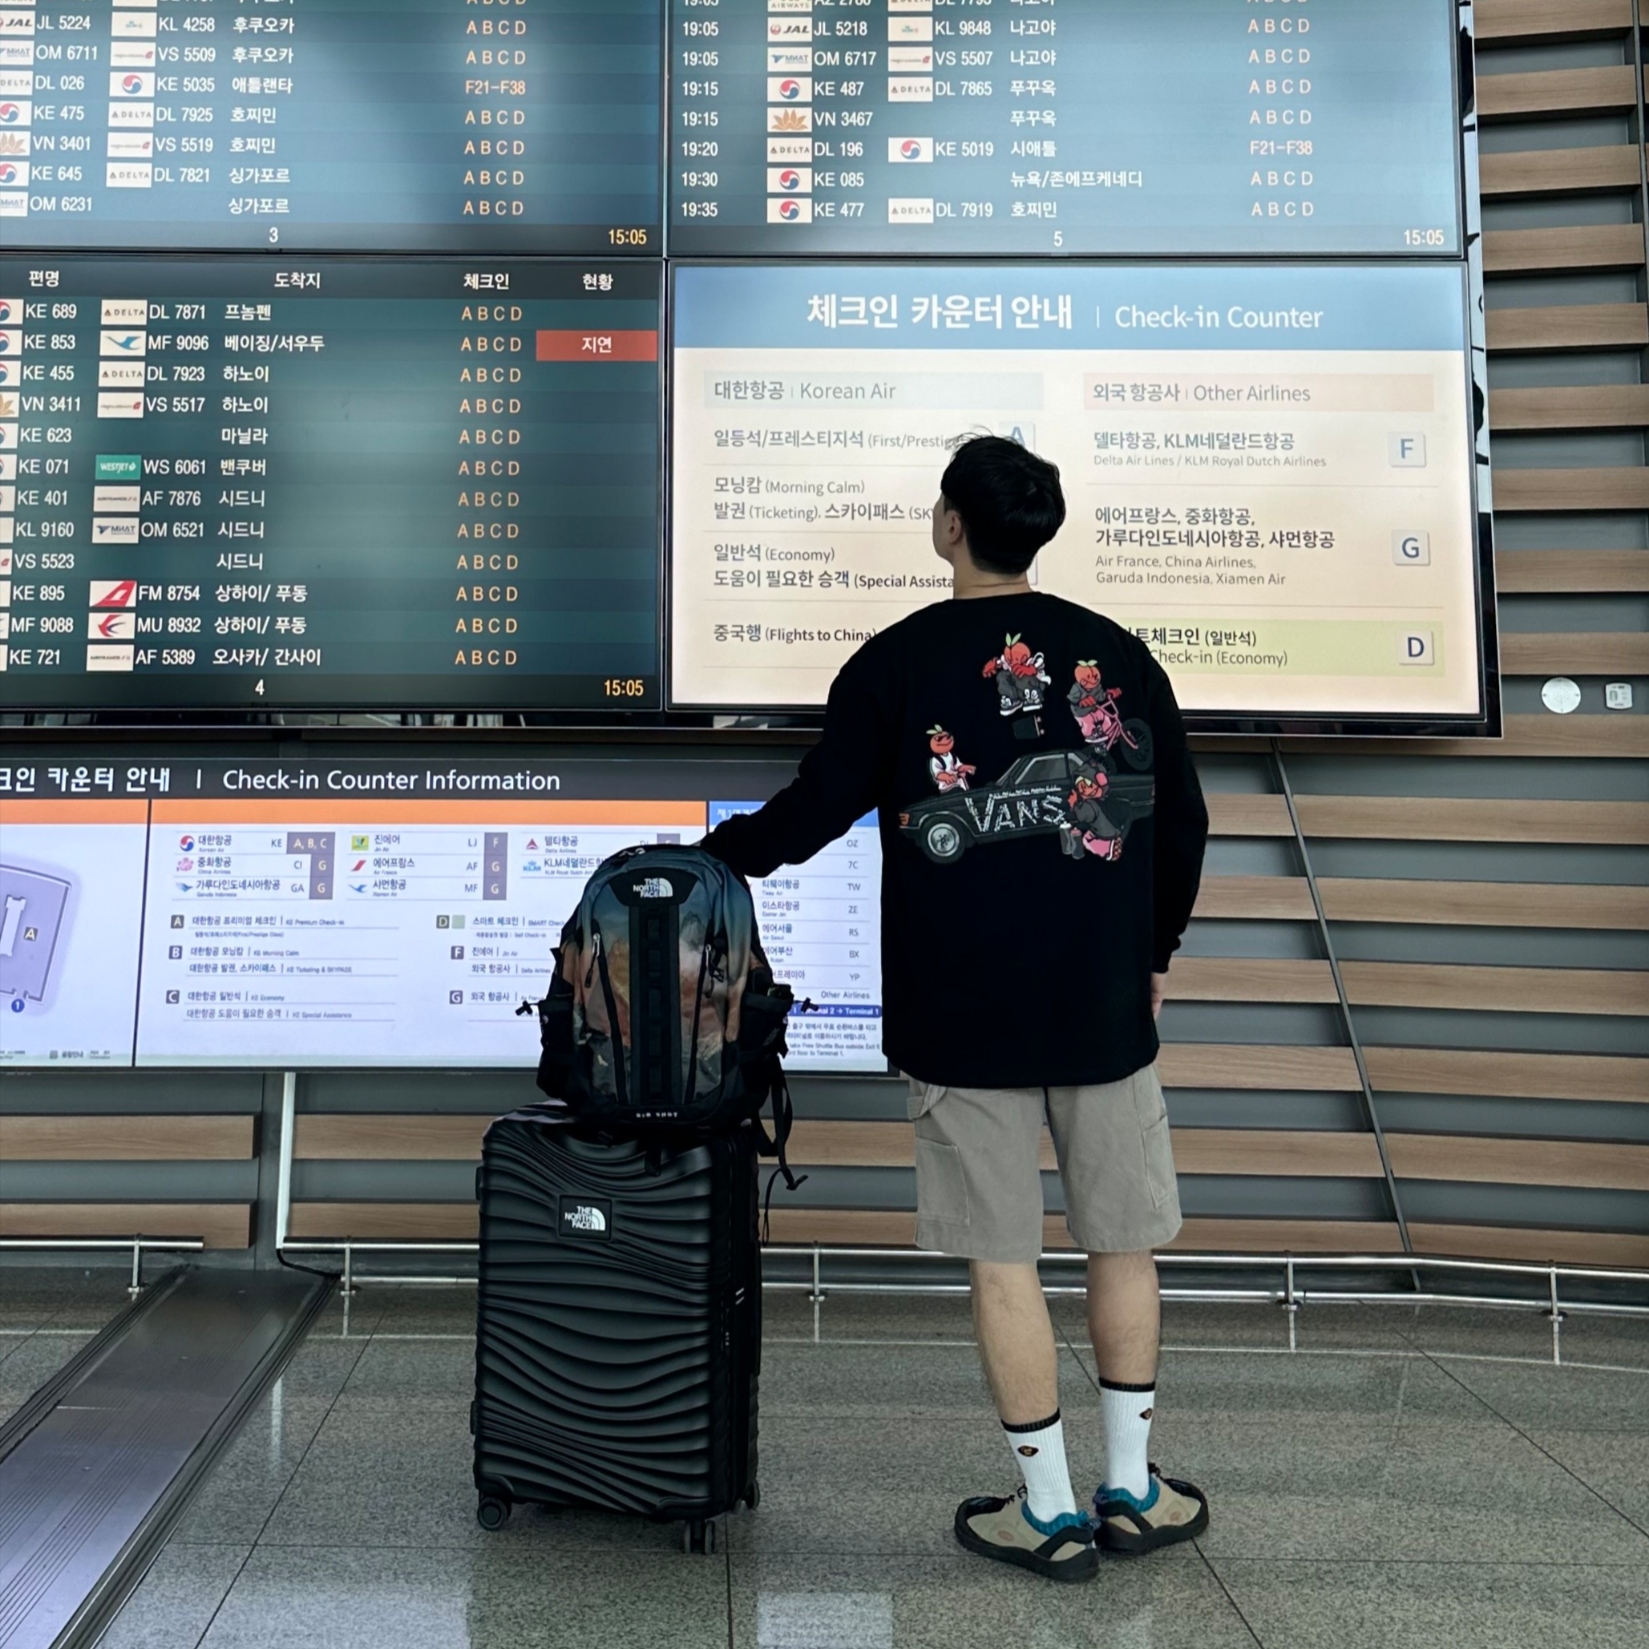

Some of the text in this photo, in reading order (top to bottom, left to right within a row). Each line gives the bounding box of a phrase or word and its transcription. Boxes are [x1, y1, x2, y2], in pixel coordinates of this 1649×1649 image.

[6, 19, 32, 27] JAL
[233, 17, 294, 33] 후쿠오카
[683, 22, 718, 36] 19:05
[783, 24, 810, 33] JAL
[814, 22, 867, 36] JL 5218
[935, 22, 991, 35] KL 9848
[1010, 20, 1056, 37] 나고야
[35, 76, 84, 90] DL 026
[157, 78, 215, 91] KE 5035
[232, 77, 293, 93] 애틀랜타
[465, 81, 525, 95] F21-F38
[682, 82, 718, 96] 19:15
[815, 82, 864, 96] KE 487
[936, 82, 992, 96] DL 7865
[1010, 80, 1056, 96] 푸꾸옥
[682, 143, 718, 156] 19:20
[815, 143, 863, 156] DL 196
[936, 143, 993, 156] KE 5019
[1010, 141, 1057, 158] 시애틀
[1250, 141, 1313, 155] F21-F38
[1010, 170, 1142, 188] 뉴욕/존에프케네디
[269, 228, 278, 242] 3
[608, 229, 647, 244] 15:05
[1053, 232, 1062, 246] 5
[1404, 230, 1444, 245] 15:05
[29, 271, 59, 287] 편명
[274, 273, 321, 288] 도착지
[463, 274, 509, 290] 체크인
[583, 274, 613, 290] 현황
[26, 304, 76, 318] KE 689
[150, 305, 206, 319] DL 7871
[225, 304, 271, 321] 프놈펜
[808, 293, 1072, 330] 체크인 카운터 안내
[1115, 305, 1323, 328] Check-in Counter
[225, 335, 325, 352] 베이징/서우두
[582, 337, 612, 353] 지연
[714, 380, 784, 400] 대한항공
[800, 383, 896, 400] Korean Air
[1094, 384, 1180, 402] 외국 항공사
[1194, 385, 1311, 401] Other Airlines
[714, 429, 863, 448] 일등석/프레스티지석
[1094, 432, 1294, 450] 델타항공, KLM네덜란드항공
[1400, 439, 1414, 459] F
[100, 463, 129, 472] WESTJET
[144, 461, 206, 474] WS 6061
[220, 459, 266, 475] 밴쿠버
[1094, 455, 1174, 466] Delta Air Lines
[1185, 455, 1326, 468] KLM Royal Dutch Airlines
[714, 477, 865, 496] 모닝캄 (Morning Calm)
[714, 502, 745, 520] 발권
[825, 503, 905, 520] 스카이패스
[1096, 508, 1255, 526] 에어프랑스, 중화항공,
[1096, 530, 1335, 549] 가루다인도네시아항공, 샤먼항공
[714, 544, 835, 563] 일반석 (Economy)
[1401, 538, 1419, 559] G
[1096, 556, 1256, 569] Air France, China Airlines,
[714, 570, 953, 589] 도움이 필요한 승객 (Special Assista
[1096, 572, 1286, 585] Garuda Indonesia, Xiamen Air
[139, 586, 200, 600] FM 8754
[215, 584, 307, 602] 상하이/ 푸동
[714, 625, 761, 642] 중국행
[765, 627, 813, 644] (Flights
[817, 629, 830, 641] to
[1204, 629, 1256, 647] (일반석)
[1407, 637, 1424, 657] D
[1217, 651, 1288, 667] (Economy)
[255, 679, 264, 695] 4
[604, 680, 643, 696] 15:05
[48, 767, 114, 792] 카운터
[126, 767, 169, 792] 안내
[223, 770, 560, 790] Check-in Counter Information
[965, 785, 1067, 832] VANS
[198, 835, 232, 845] 대한항공
[272, 839, 282, 847] KE
[320, 838, 327, 848] C
[468, 839, 477, 847] LJ
[493, 838, 498, 847] F
[847, 840, 858, 848] OZ
[318, 861, 326, 870] G
[492, 863, 499, 872] G
[848, 861, 858, 869] 7C
[196, 880, 280, 890] 가루다인도네시아항공
[291, 884, 304, 892] GA
[318, 884, 325, 893] G
[465, 884, 477, 892] MF
[848, 883, 861, 891] TW
[174, 917, 182, 927] A
[565, 1213, 592, 1221] NORTH
[577, 1206, 592, 1214] THE
[572, 1221, 592, 1229] FACE
